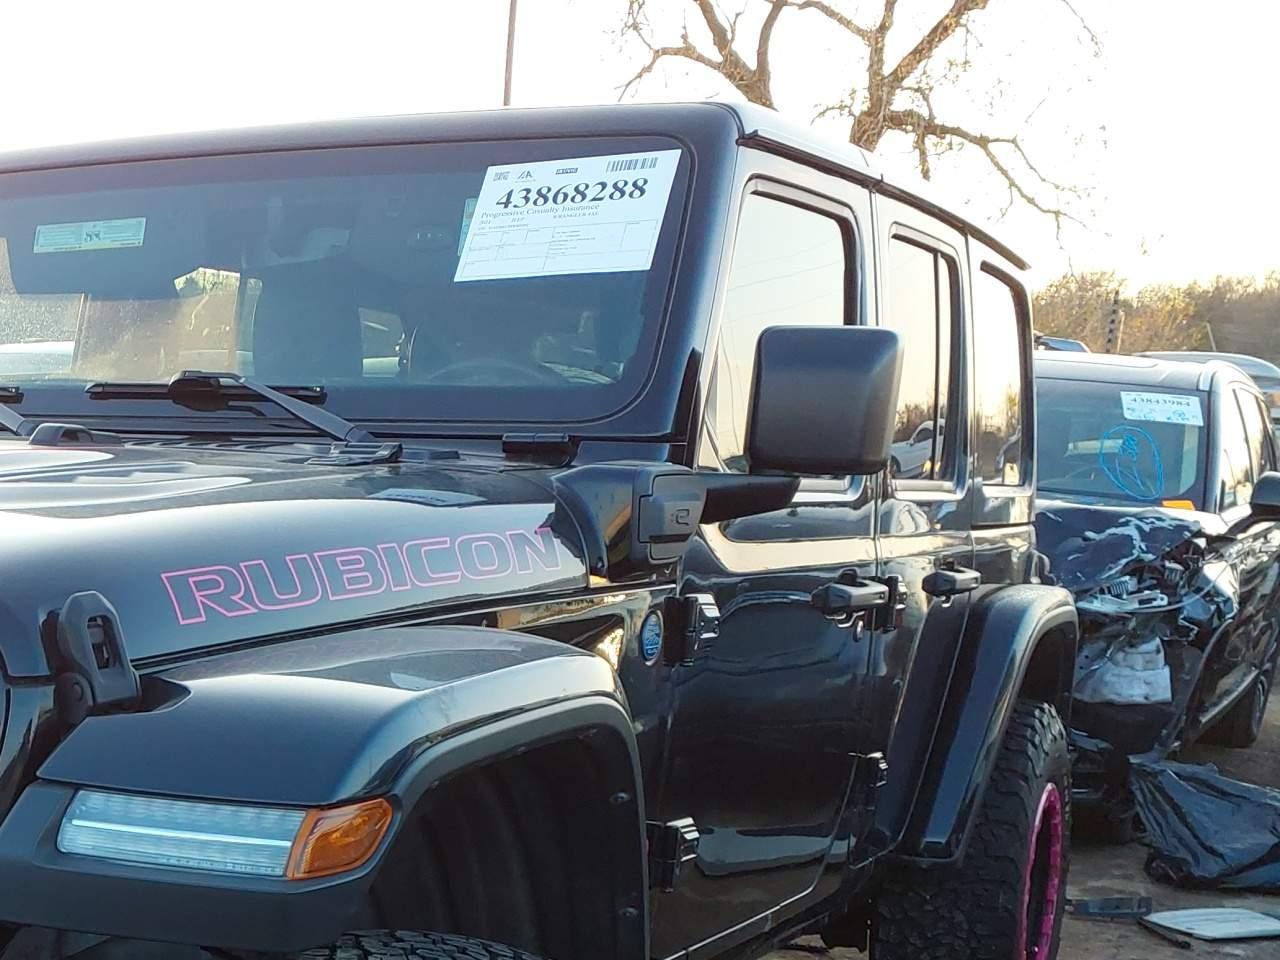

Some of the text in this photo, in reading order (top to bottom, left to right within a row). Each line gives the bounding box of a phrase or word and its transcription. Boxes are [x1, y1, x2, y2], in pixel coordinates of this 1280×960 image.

[495, 177, 649, 209] 43868288
[481, 203, 600, 219] Progressive Casualty Insurance
[160, 527, 562, 625] RUBICON
